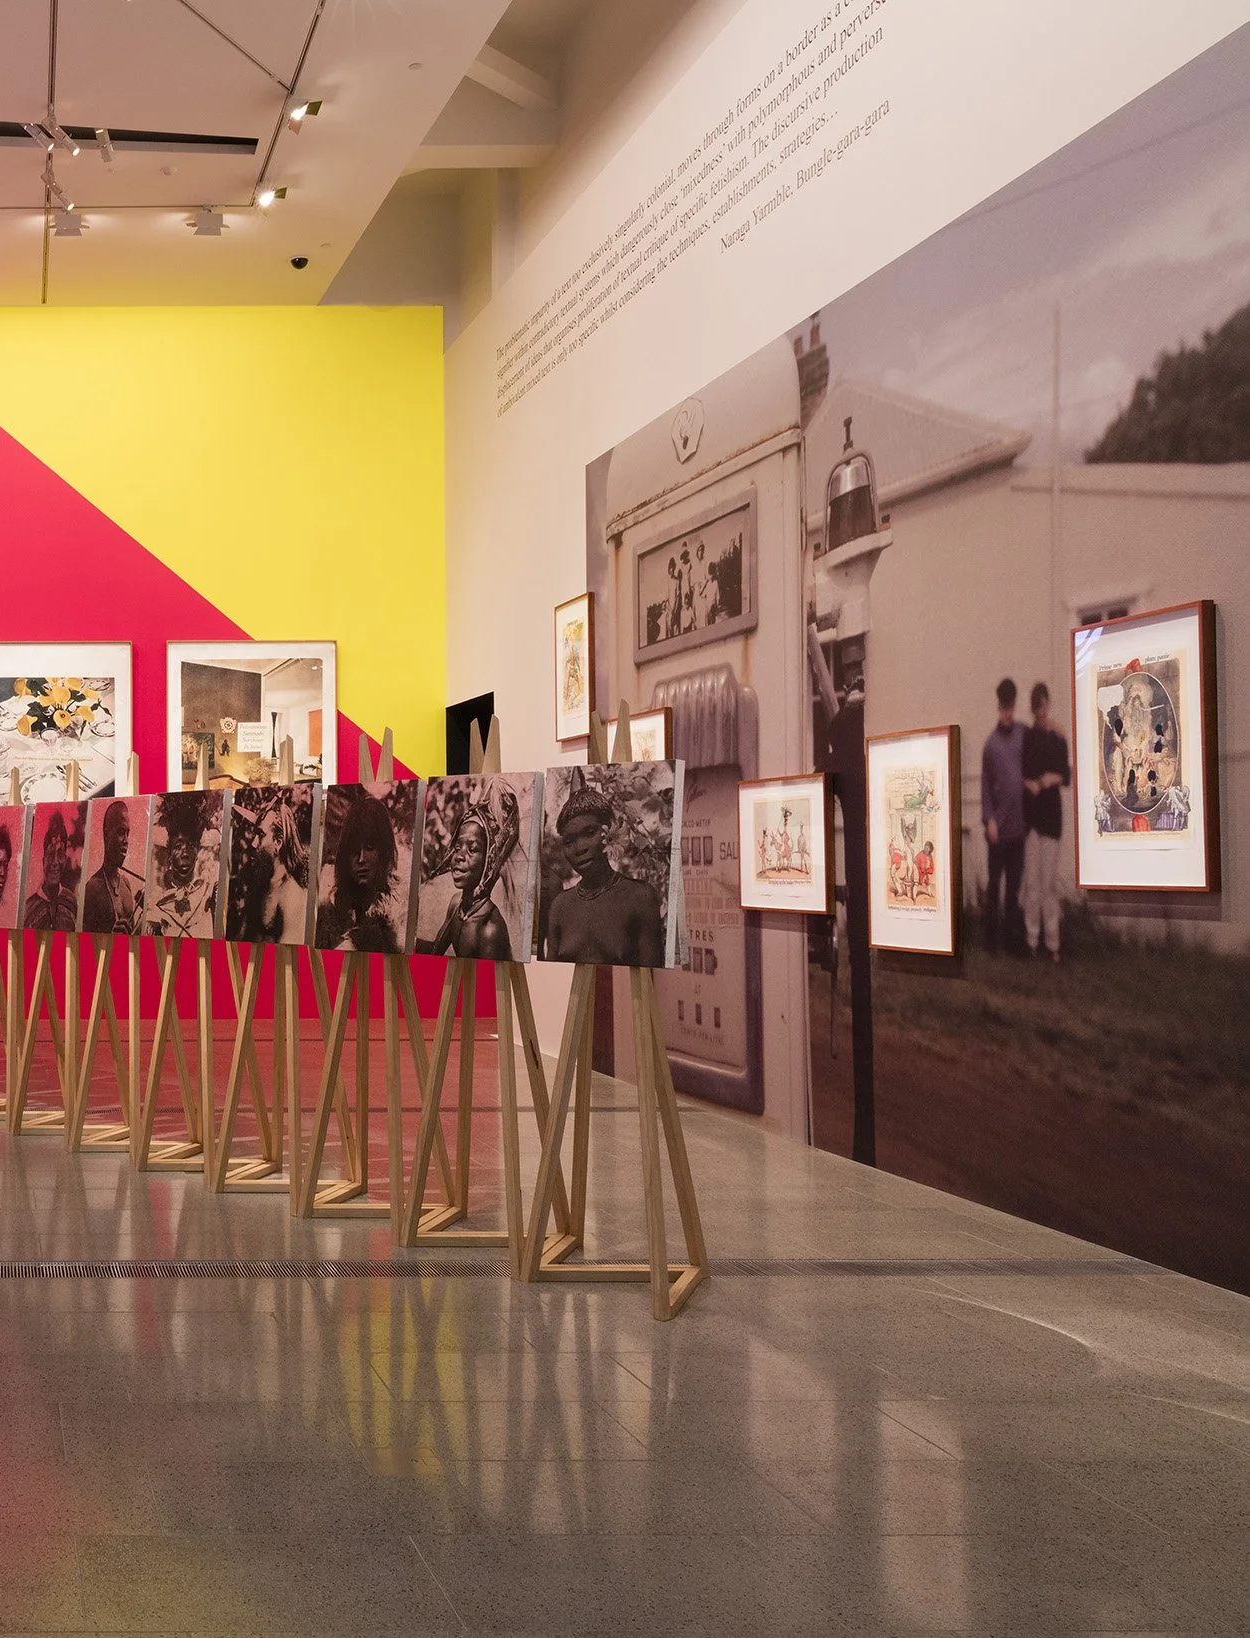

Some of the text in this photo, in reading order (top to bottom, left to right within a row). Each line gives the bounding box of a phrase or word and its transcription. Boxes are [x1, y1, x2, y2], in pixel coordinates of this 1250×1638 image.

[578, 271, 601, 302] systems
[601, 250, 620, 277] which
[620, 213, 658, 259] dangerously
[660, 195, 678, 220] close
[727, 126, 746, 154] with
[747, 59, 816, 139] polymorphous
[817, 32, 837, 66] and
[839, 0, 887, 51] pervers
[582, 234, 613, 274] exclusively
[614, 201, 645, 241] singularly
[677, 144, 702, 177] moves
[703, 108, 734, 150] through
[735, 83, 762, 117] forms
[763, 69, 776, 88] on
[777, 61, 784, 75] a
[785, 25, 819, 67] border
[820, 11, 832, 32] as
[834, 2, 841, 17] a
[599, 300, 618, 324] whilst
[618, 267, 656, 308] considering
[656, 256, 668, 274] the
[669, 220, 711, 263] techniques,
[712, 159, 777, 224] establishments,
[612, 271, 621, 291] of
[620, 250, 643, 282] textual
[643, 229, 669, 262] critique
[670, 214, 679, 237] of
[680, 192, 708, 230] specific
[709, 155, 750, 200] fetishism.
[752, 134, 770, 159] The
[771, 86, 820, 141] discursive
[823, 27, 883, 99] production
[719, 219, 751, 254] Naraga
[796, 98, 890, 190] Bungle-gara-gara
